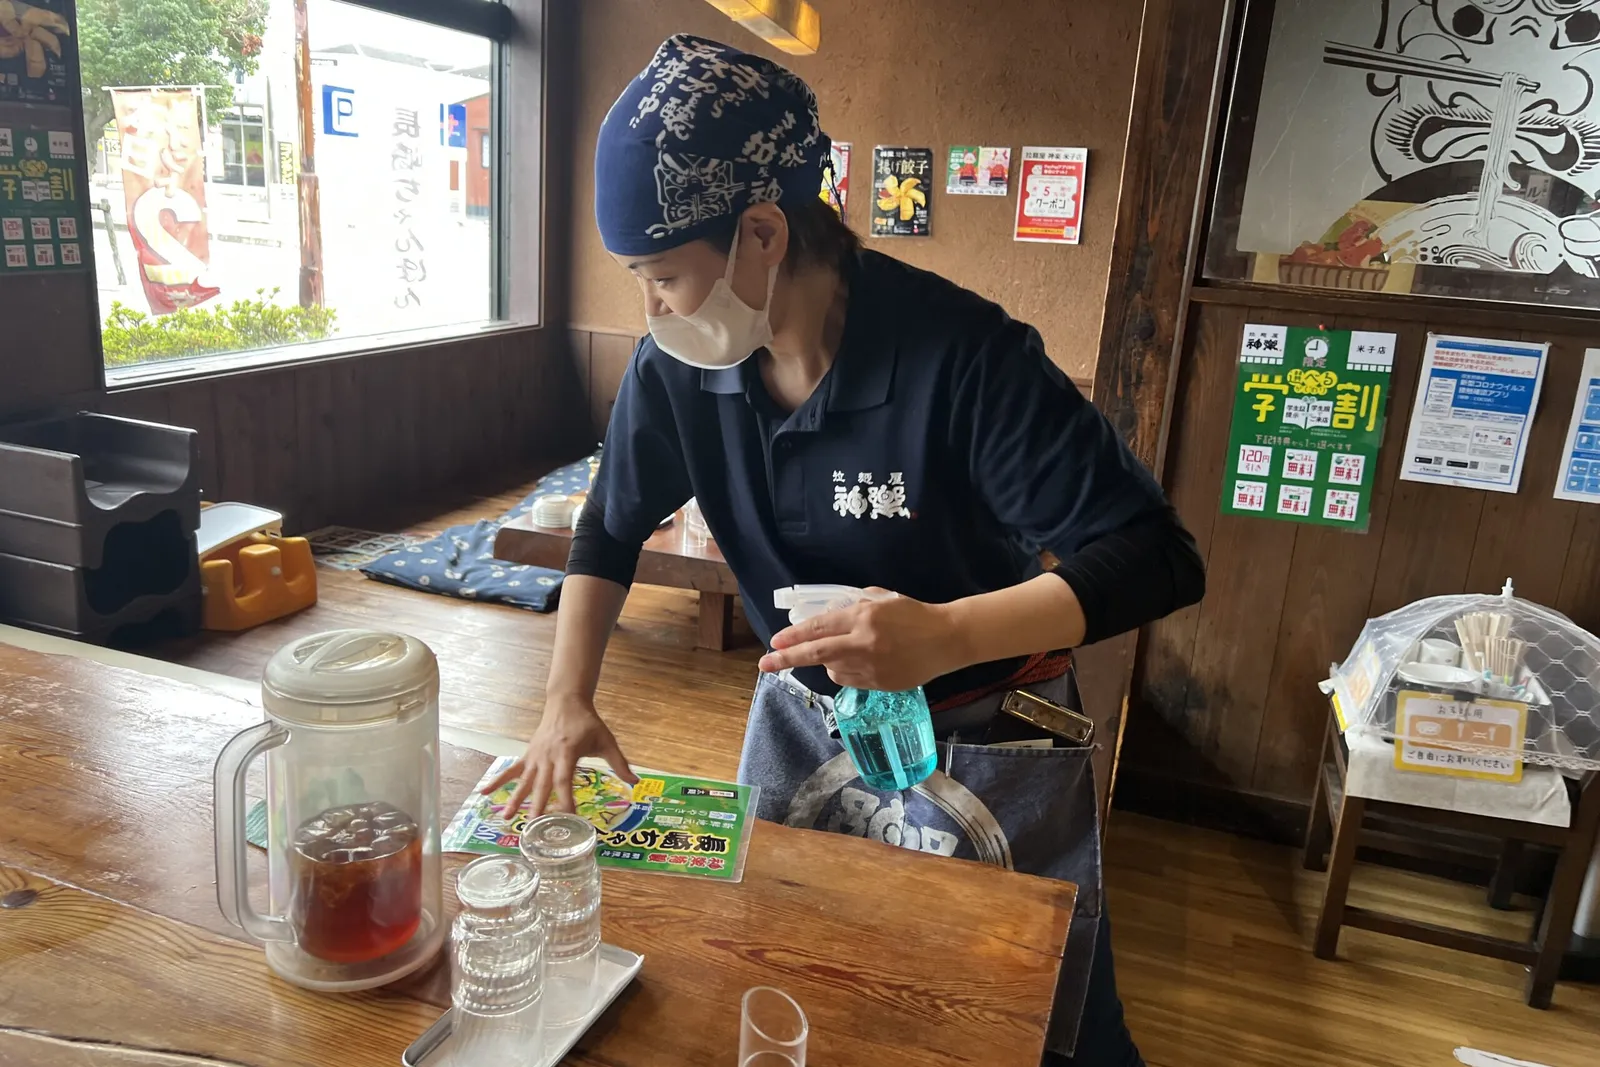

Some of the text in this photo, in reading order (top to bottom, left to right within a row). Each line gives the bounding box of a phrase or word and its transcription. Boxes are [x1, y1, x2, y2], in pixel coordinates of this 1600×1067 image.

[876, 159, 929, 175] 揚げ餃子
[1036, 198, 1067, 210] クーポン
[1356, 344, 1387, 355] 米子店
[1302, 356, 1328, 369] 限定
[1241, 448, 1270, 464] 120円
[1407, 750, 1511, 769] ご自由にお取りください
